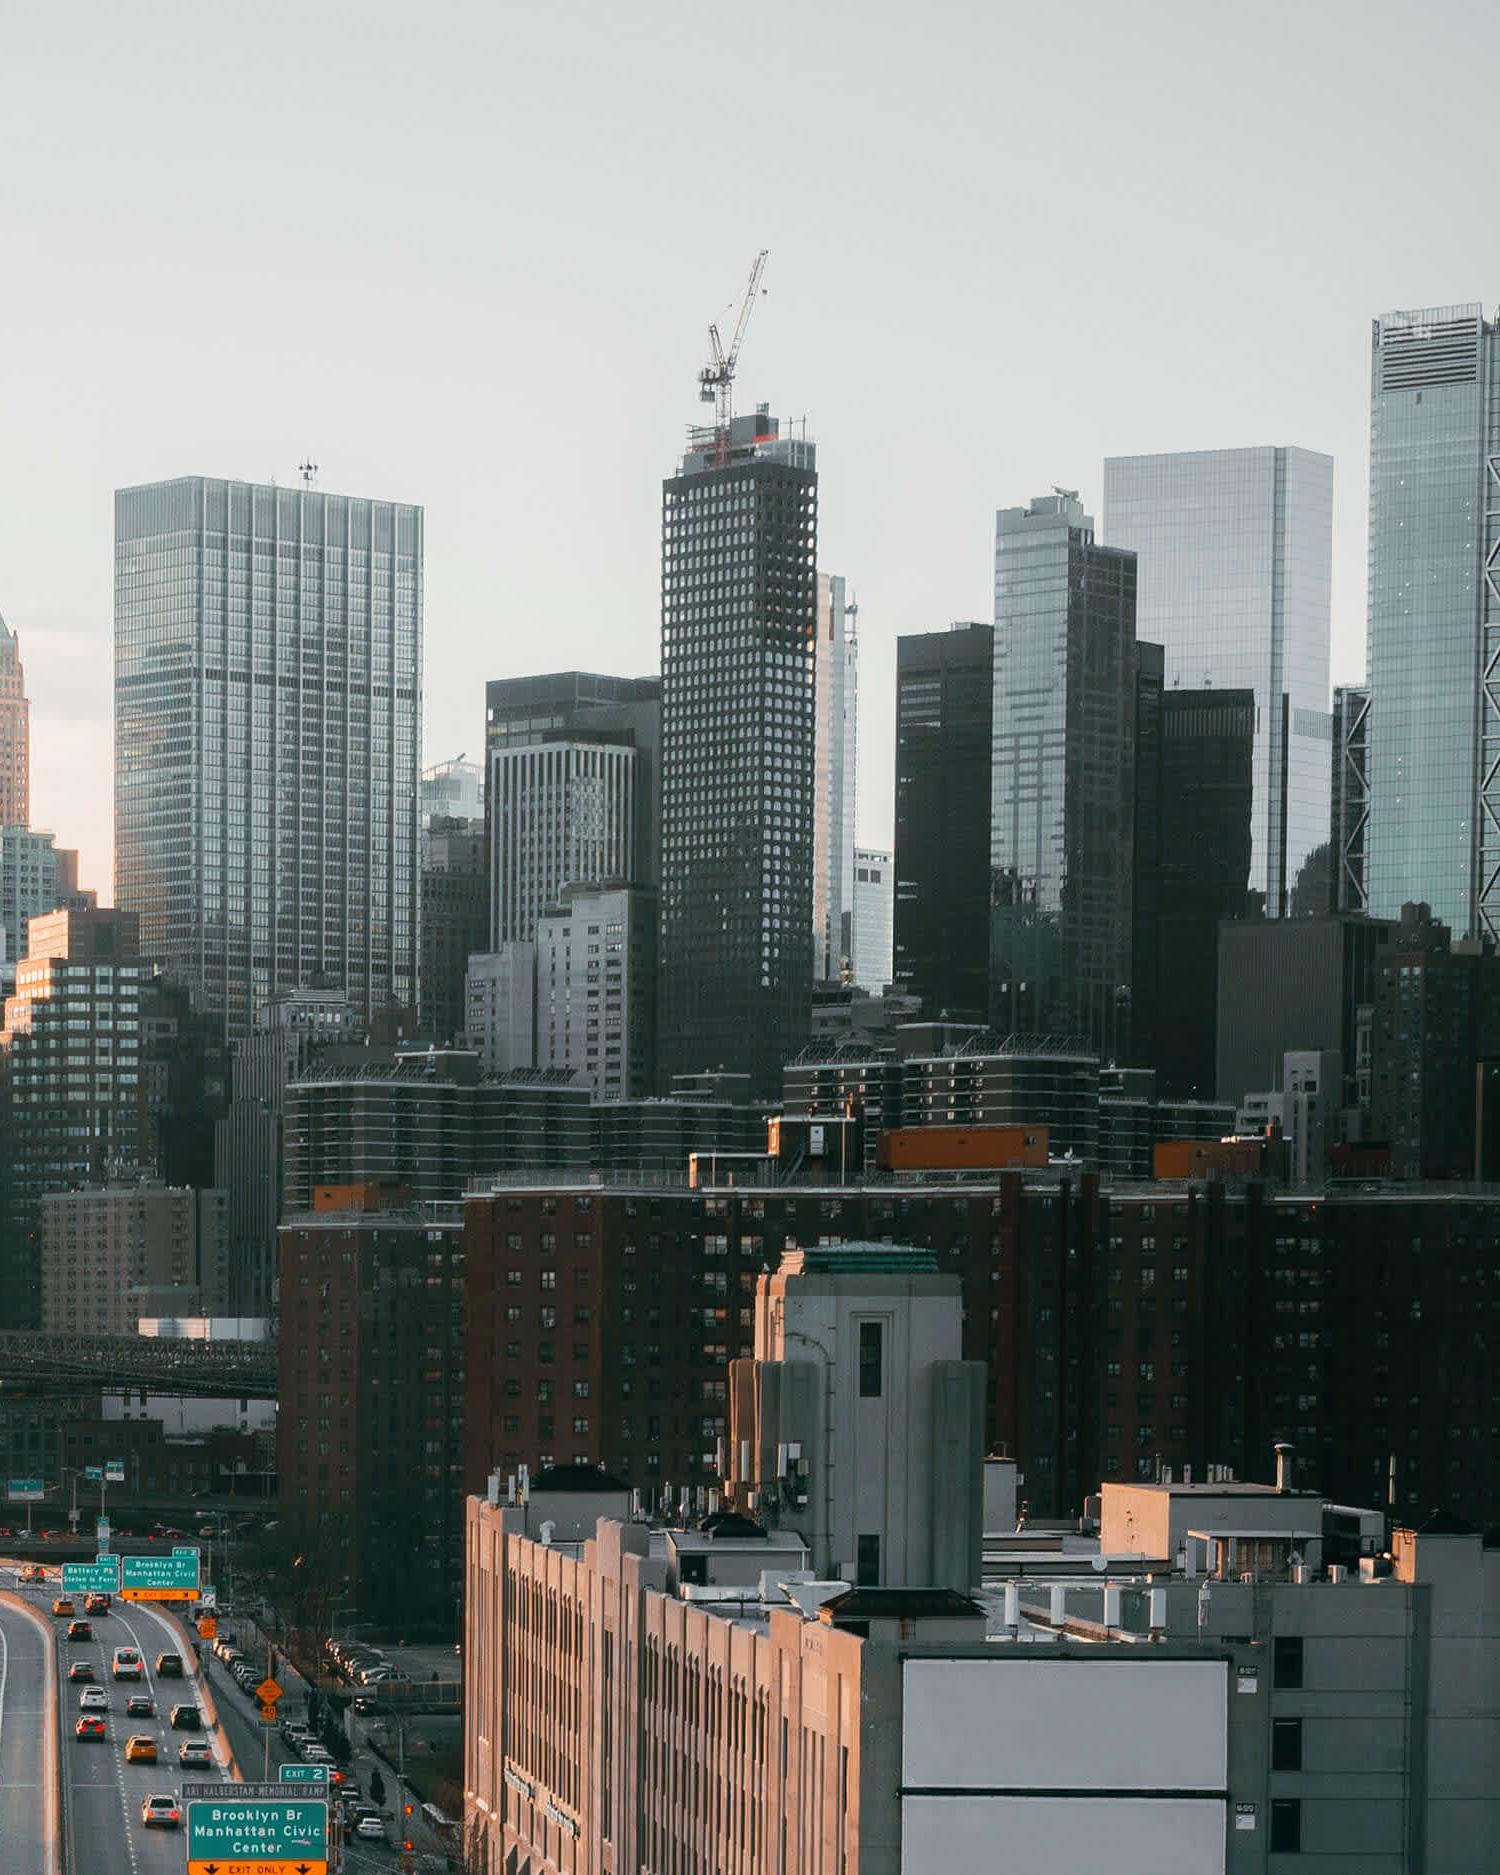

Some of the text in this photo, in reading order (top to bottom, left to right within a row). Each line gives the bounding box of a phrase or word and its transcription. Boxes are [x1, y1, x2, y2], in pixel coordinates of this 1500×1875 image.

[67, 1567, 99, 1575] Battery
[285, 1768, 323, 1779] EXIT 2
[260, 1785, 298, 1797] MEMORIAL
[212, 1809, 303, 1823] Brooklyn Br
[194, 1825, 321, 1837] Manhattan Civic
[232, 1842, 283, 1853] Center
[228, 1865, 286, 1875] EXIT ONLY
